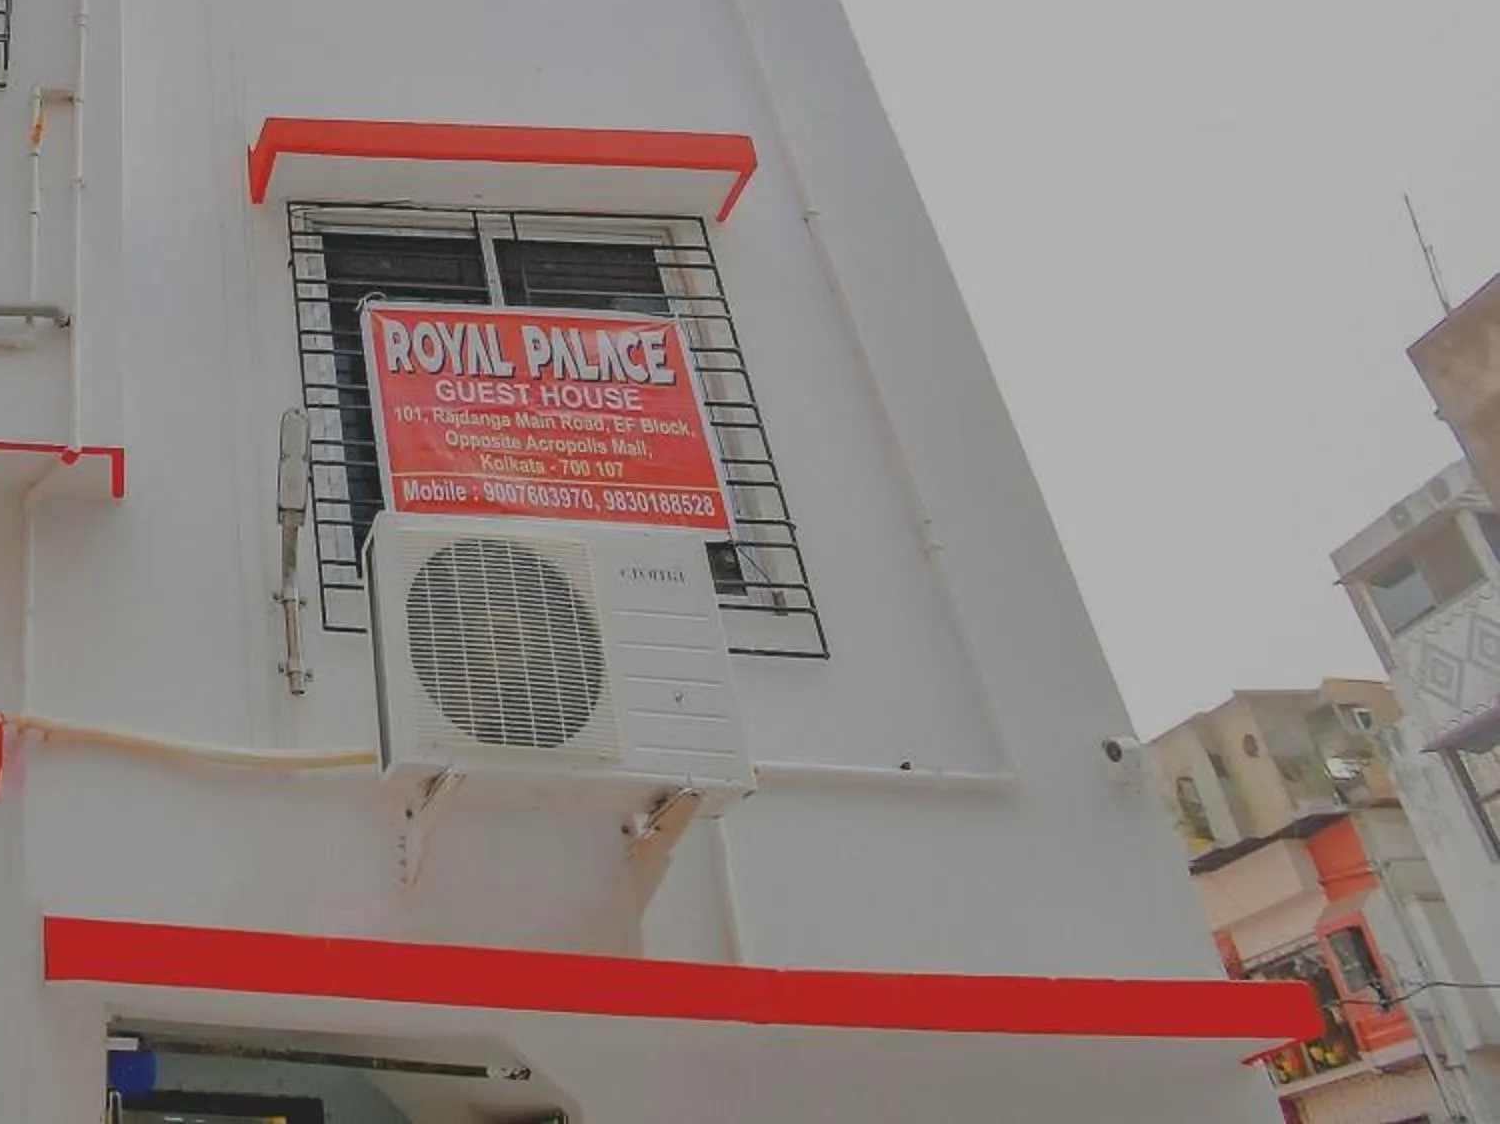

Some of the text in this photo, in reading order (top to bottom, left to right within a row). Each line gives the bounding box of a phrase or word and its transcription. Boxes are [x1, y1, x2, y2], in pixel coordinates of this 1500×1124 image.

[383, 320, 676, 384] ROYAL PALACE
[435, 380, 643, 411] GUEST HOUSE
[433, 408, 511, 430] Rajdanga
[515, 412, 555, 428] Main
[614, 416, 636, 432] EF
[445, 430, 521, 452] Opposite
[526, 435, 607, 456] Acropolis
[479, 454, 545, 473] Kolkata
[559, 459, 590, 476] 700
[596, 462, 624, 478] 107
[403, 479, 467, 502] Mobile
[603, 490, 715, 517] 9830188528
